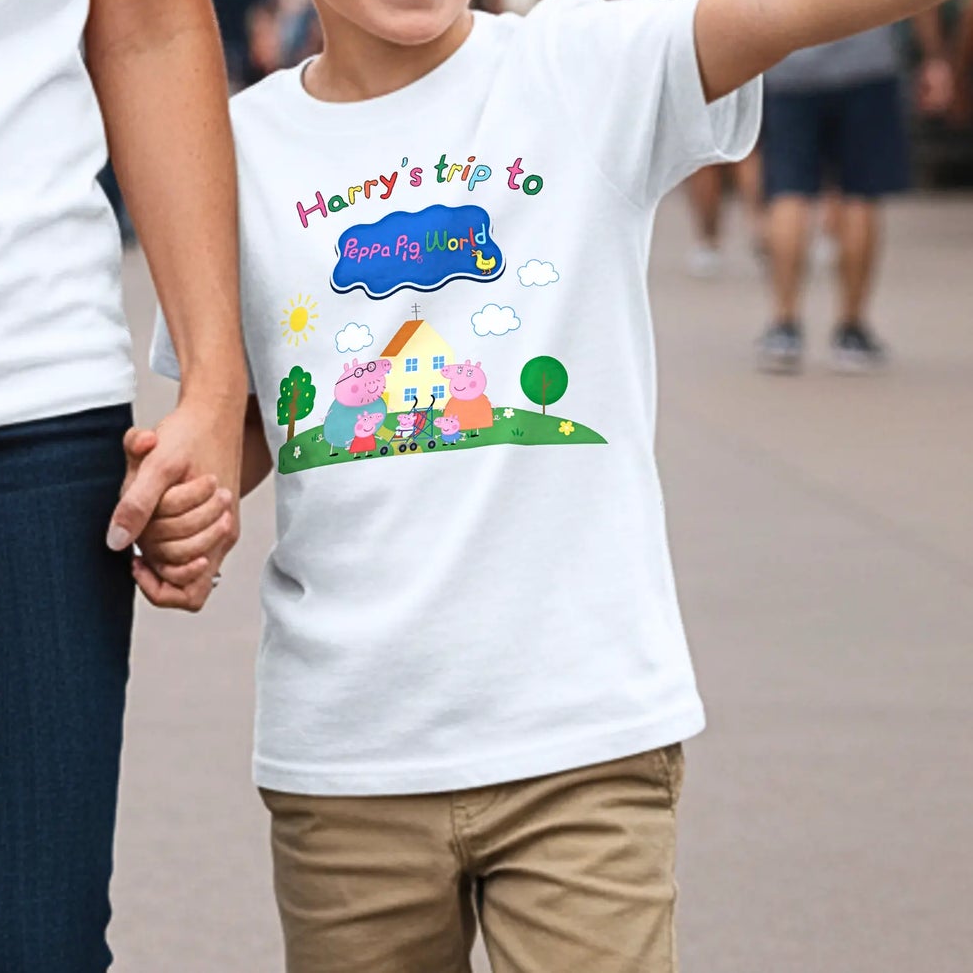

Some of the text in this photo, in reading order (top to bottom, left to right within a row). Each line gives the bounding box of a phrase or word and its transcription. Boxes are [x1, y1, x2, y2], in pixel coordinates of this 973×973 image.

[296, 154, 544, 228] Harry's trip to
[343, 223, 487, 263] Peppa Pig World
